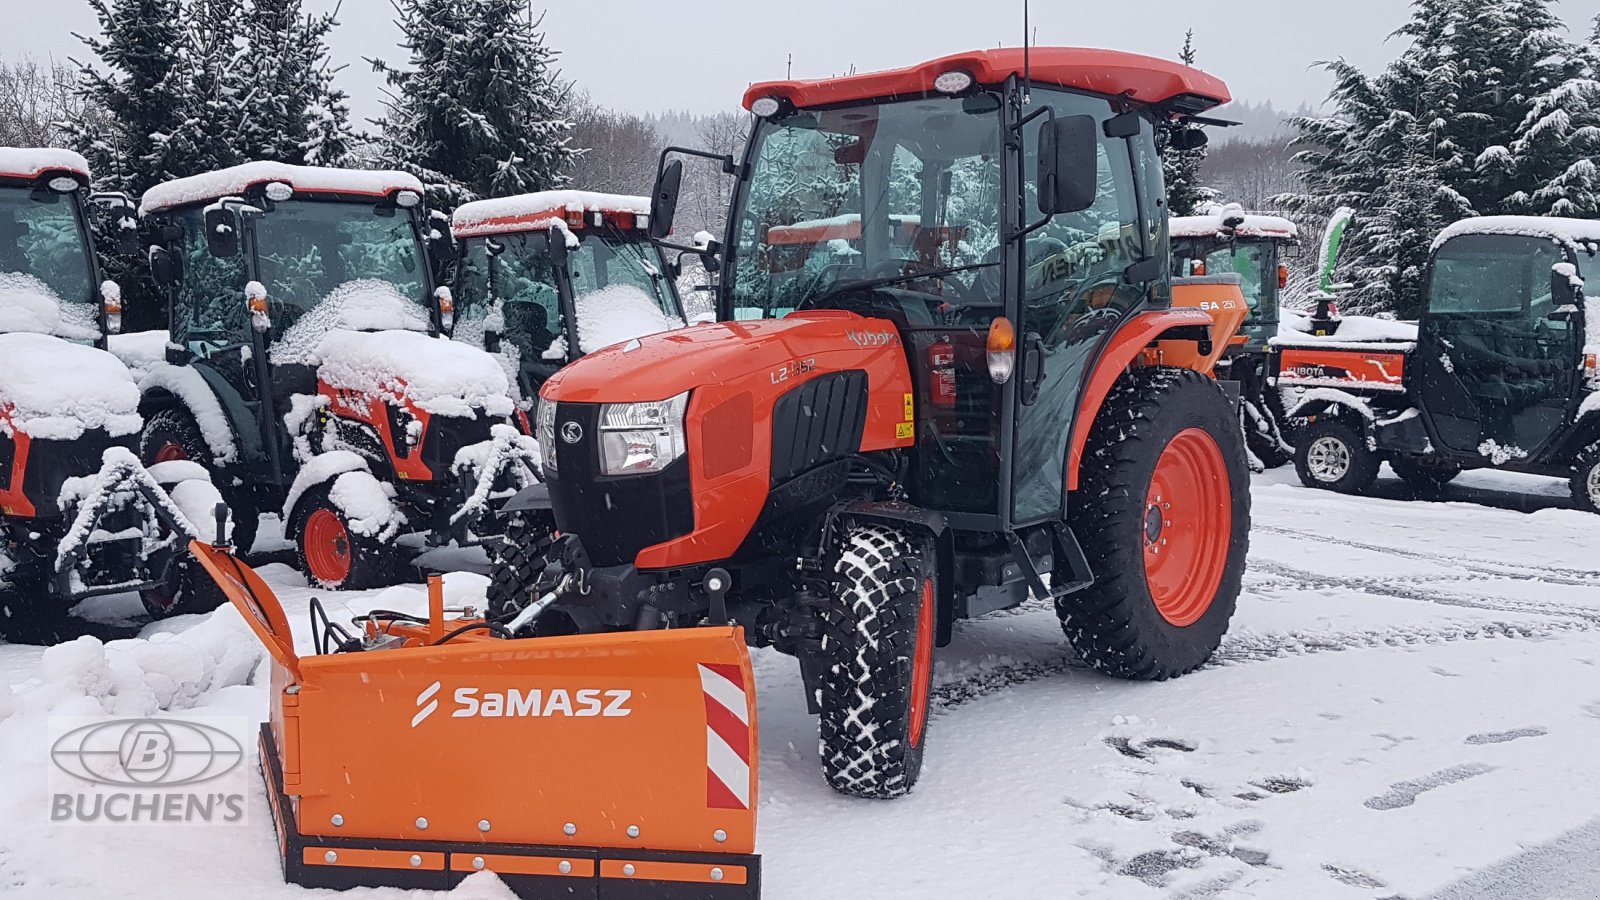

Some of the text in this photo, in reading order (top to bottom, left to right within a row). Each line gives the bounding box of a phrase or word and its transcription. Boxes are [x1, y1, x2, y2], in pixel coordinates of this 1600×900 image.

[1200, 301, 1219, 310] SA
[845, 329, 900, 346] Kubota
[1286, 366, 1324, 376] KUBOTA
[452, 687, 632, 717] SaMASZ
